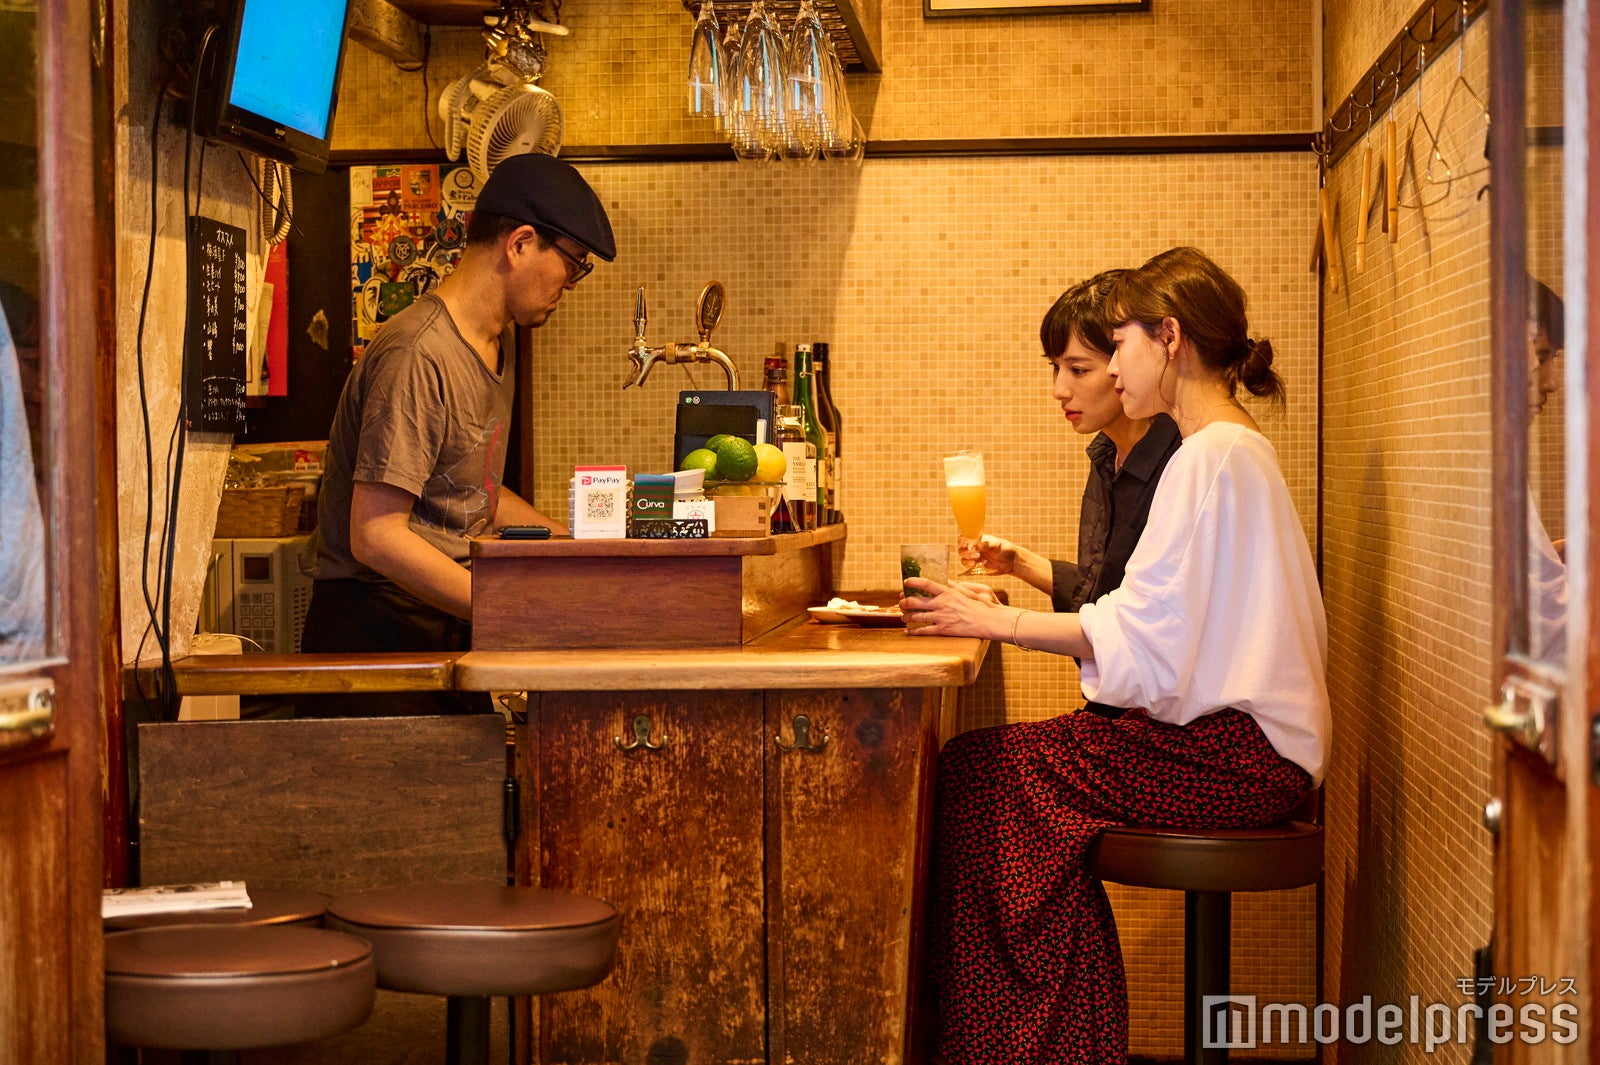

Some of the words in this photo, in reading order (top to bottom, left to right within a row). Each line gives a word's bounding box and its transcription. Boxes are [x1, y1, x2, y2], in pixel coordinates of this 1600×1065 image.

[216, 228, 234, 248] オススメ
[592, 476, 621, 485] PayPay
[637, 498, 665, 510] Curva
